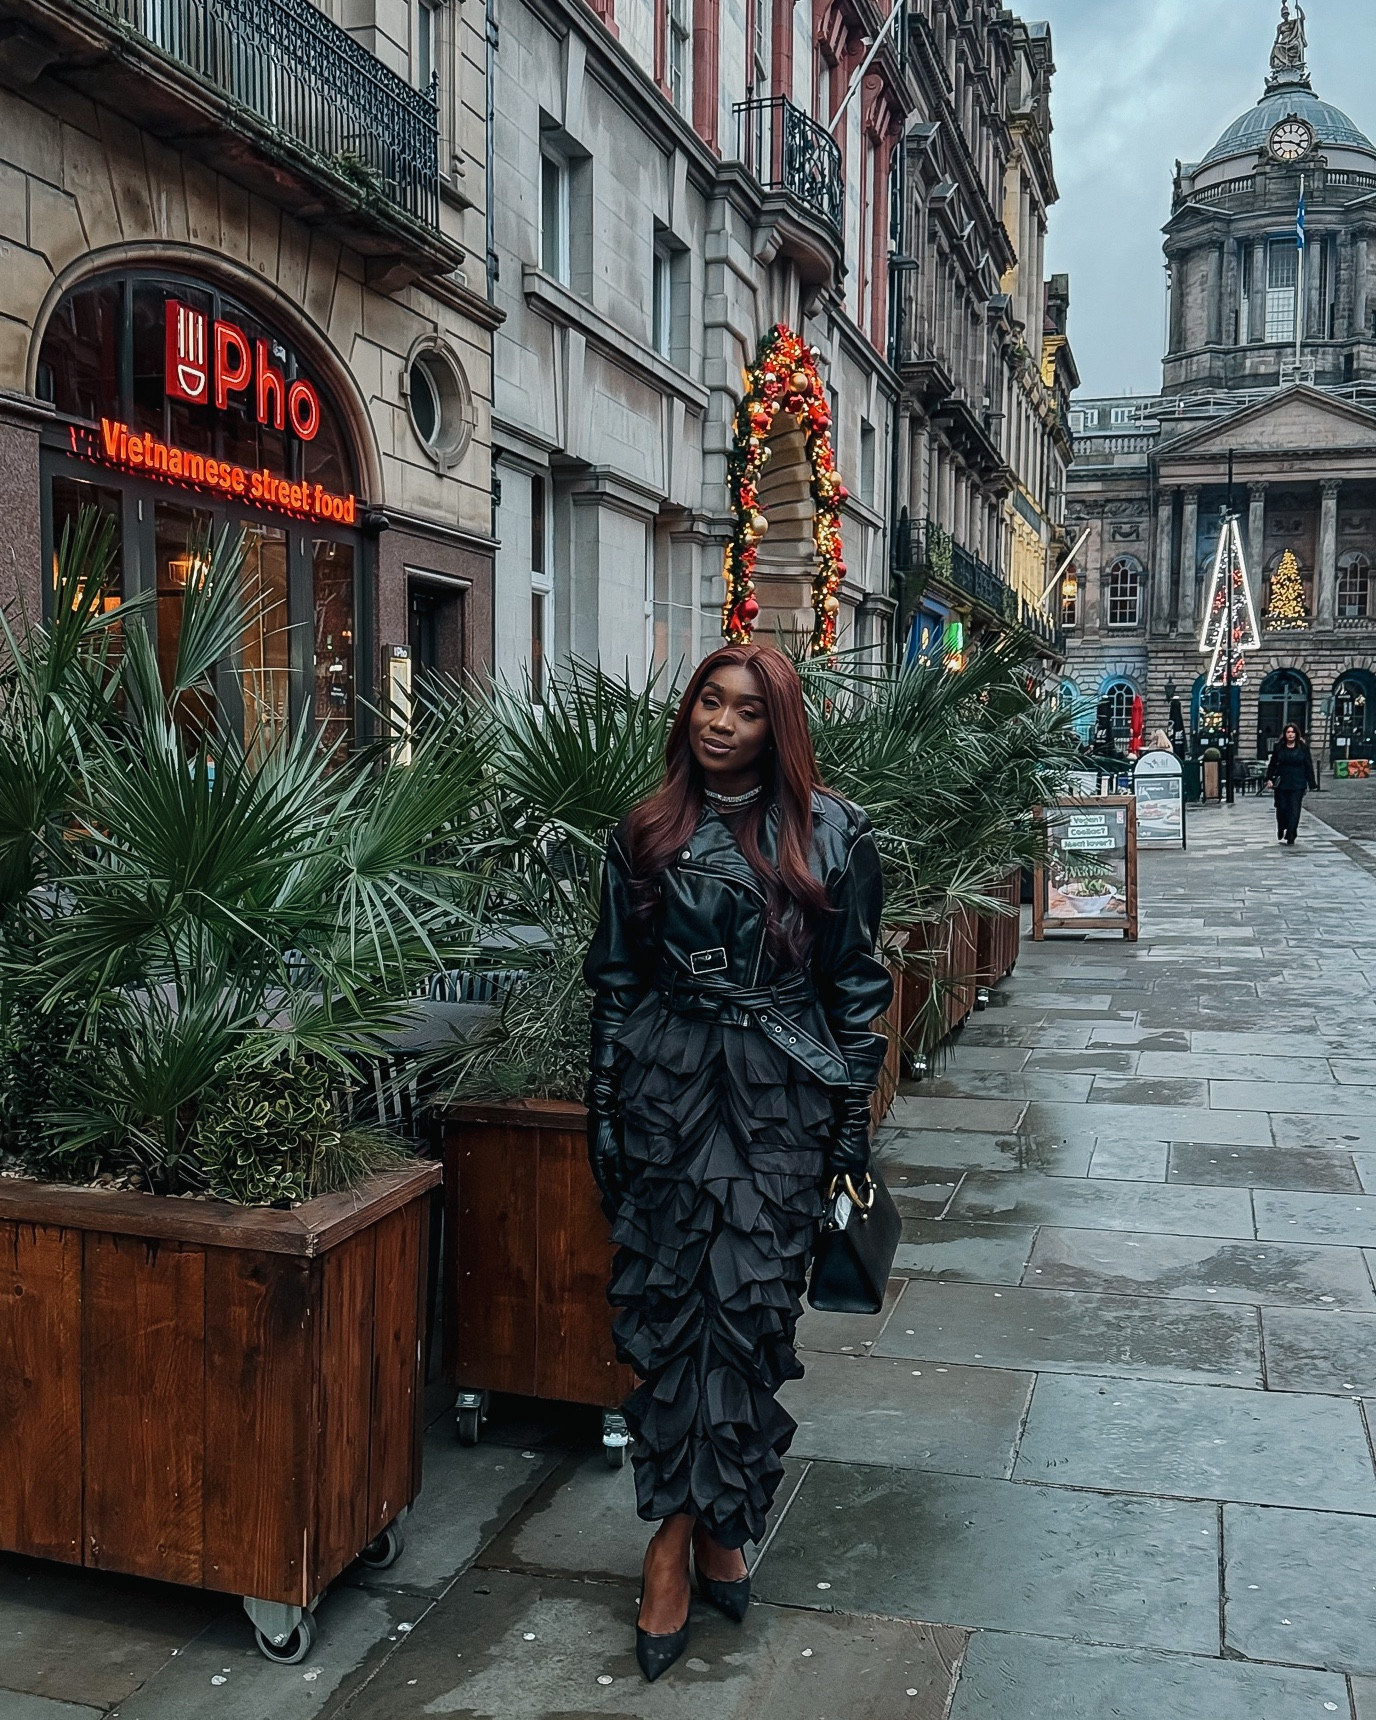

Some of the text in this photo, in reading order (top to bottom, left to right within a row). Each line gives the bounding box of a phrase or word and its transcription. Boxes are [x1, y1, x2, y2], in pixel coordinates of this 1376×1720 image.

[214, 319, 320, 441] Pho
[101, 417, 355, 523] Vietnamese street food
[1086, 839, 1113, 848] lover?
